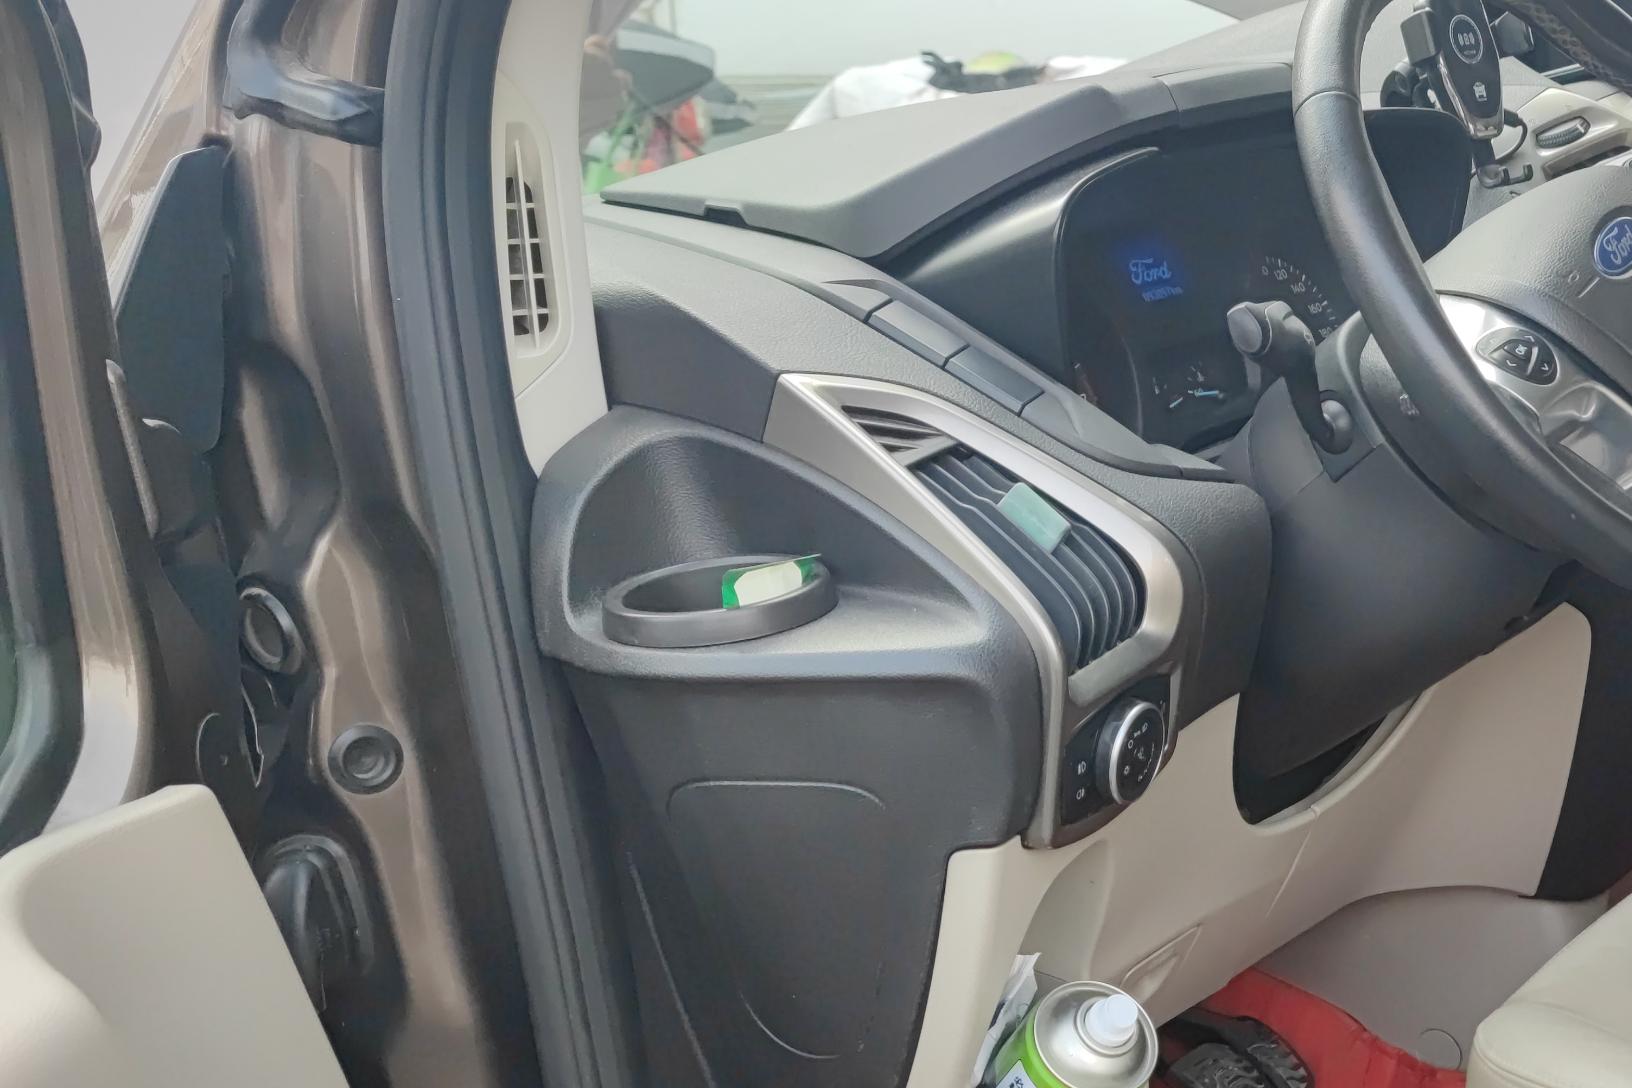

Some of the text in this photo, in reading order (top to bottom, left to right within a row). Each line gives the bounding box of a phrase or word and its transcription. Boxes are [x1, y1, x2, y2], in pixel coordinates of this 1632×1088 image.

[1129, 258, 1172, 285] Ford
[1274, 268, 1288, 281] 120
[1291, 282, 1305, 294] 140
[1308, 303, 1322, 313] 160
